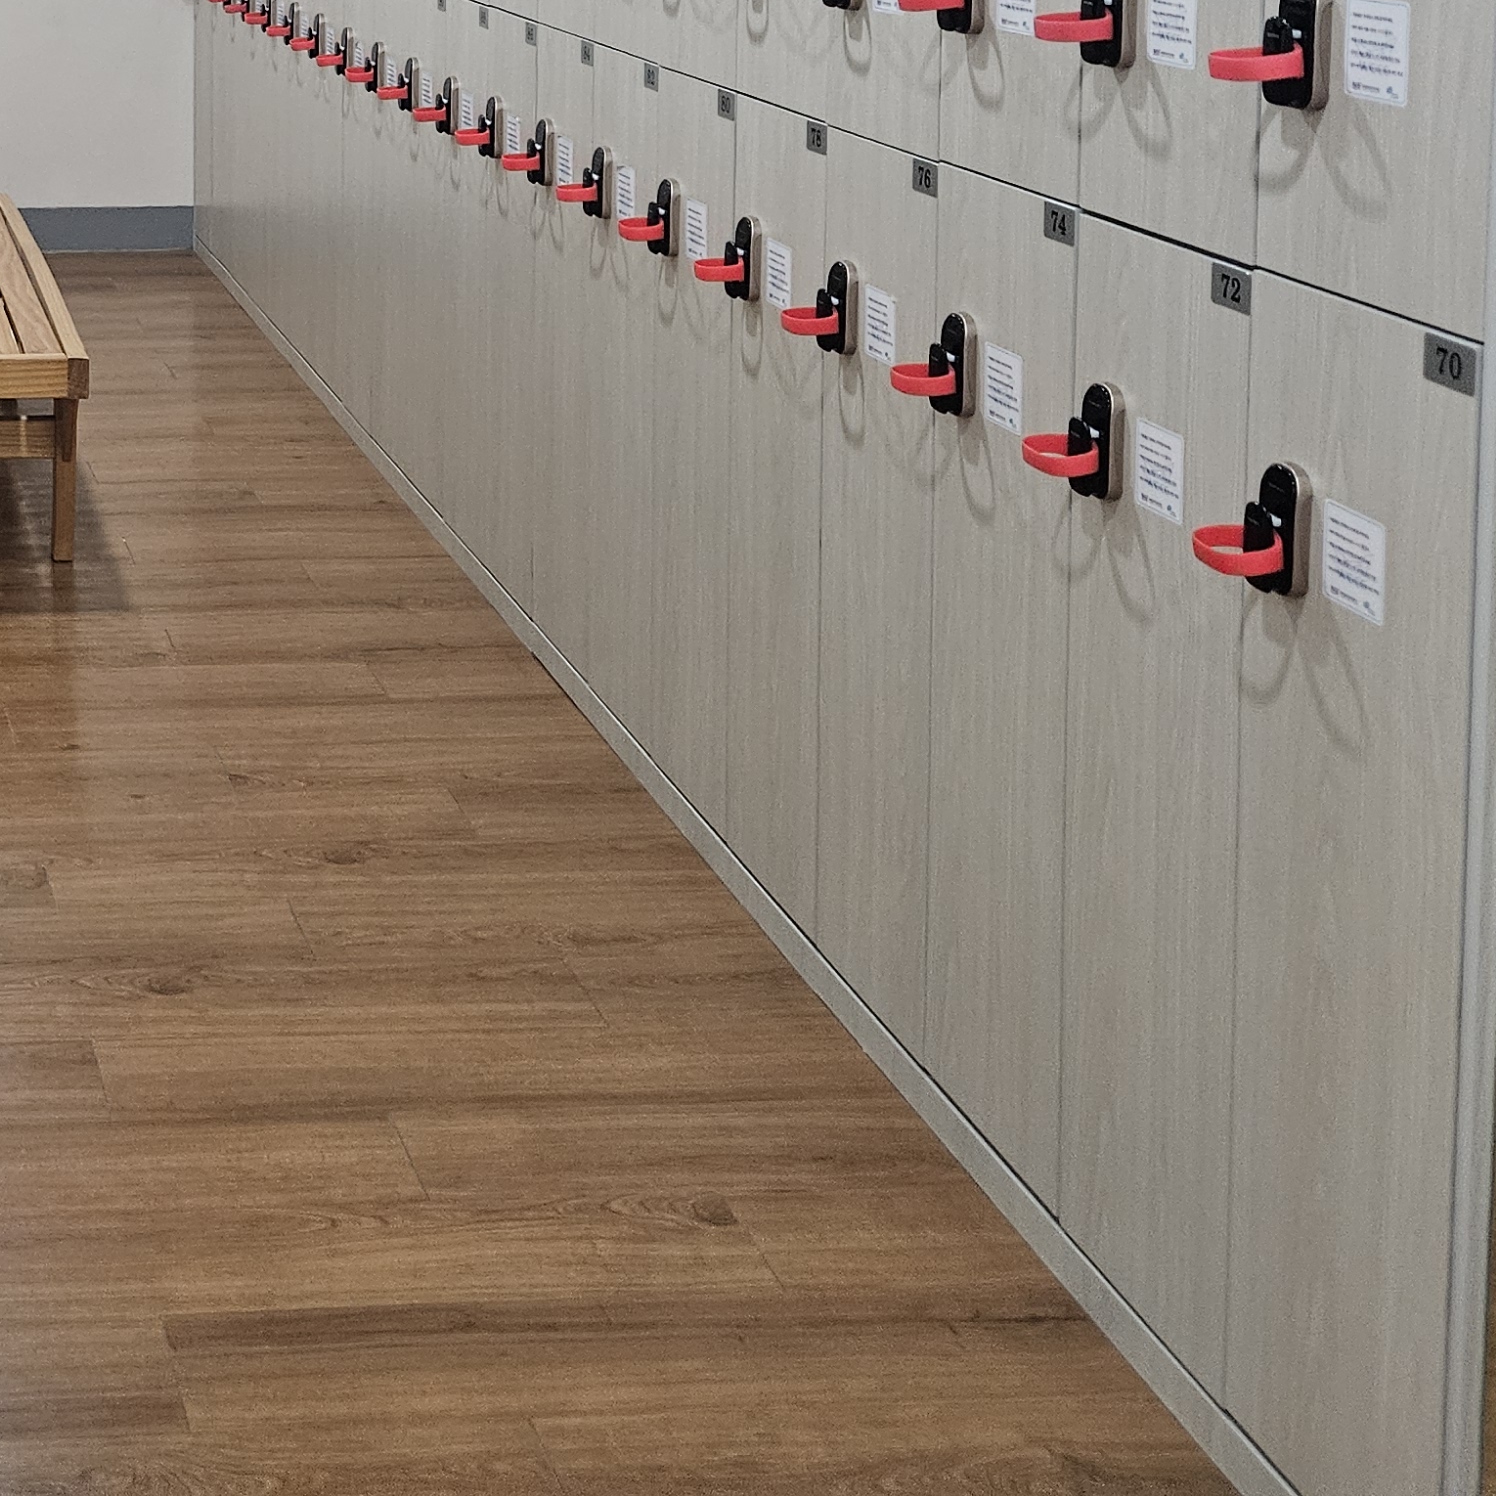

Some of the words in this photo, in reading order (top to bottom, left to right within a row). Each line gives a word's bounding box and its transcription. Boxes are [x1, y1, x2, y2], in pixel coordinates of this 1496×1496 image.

[917, 167, 932, 189] 76
[1050, 211, 1067, 236] 74
[1221, 273, 1242, 304] 72
[1436, 347, 1463, 381] 70
